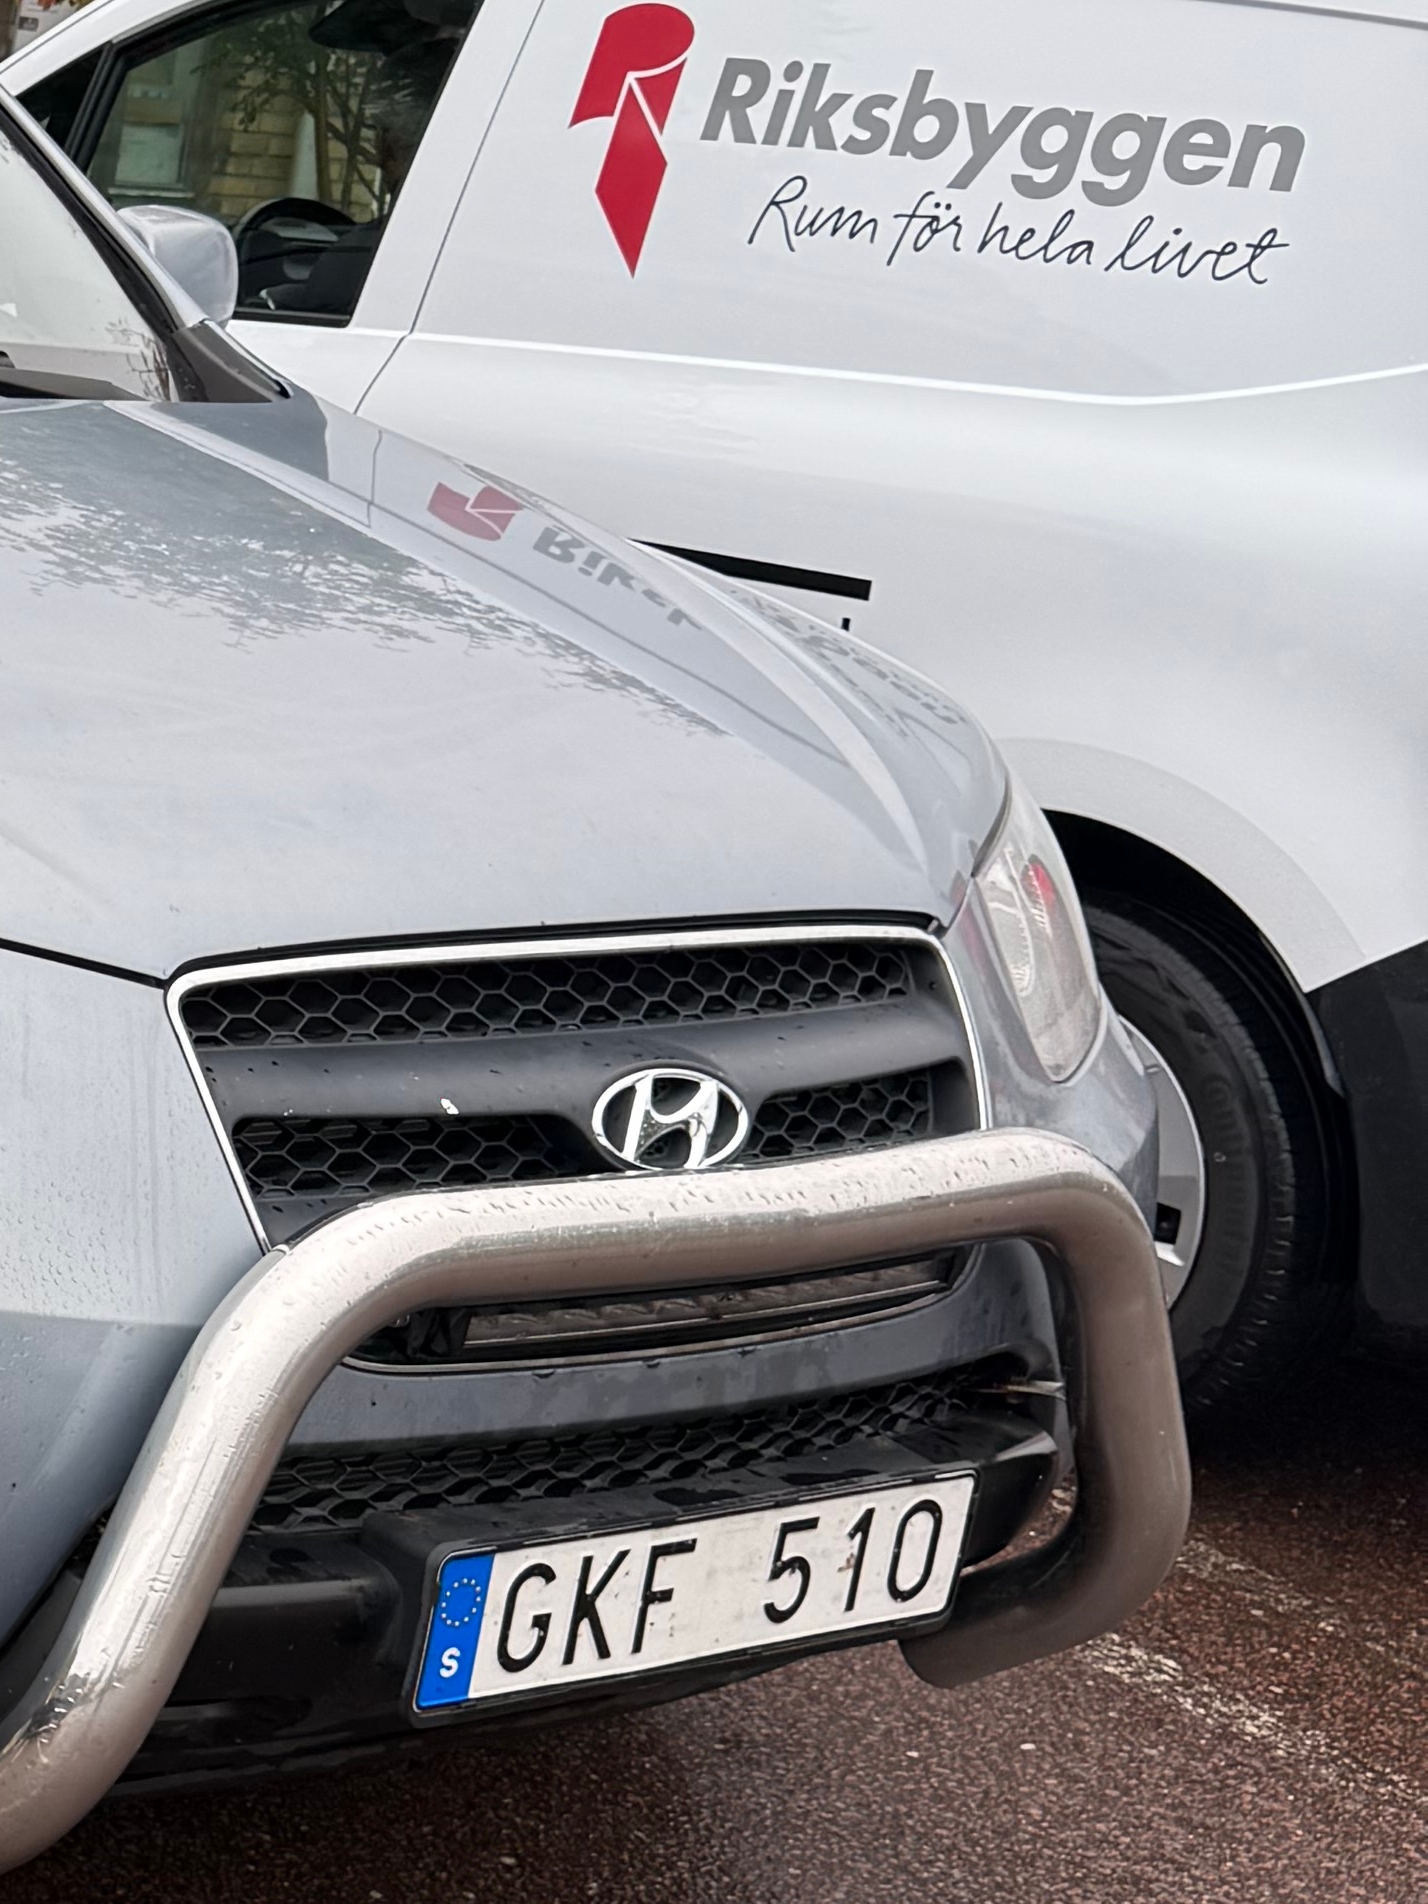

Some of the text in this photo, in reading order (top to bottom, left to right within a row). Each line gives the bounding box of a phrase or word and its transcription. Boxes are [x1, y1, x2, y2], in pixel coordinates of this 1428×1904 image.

[699, 56, 1306, 208] Riksbyggen
[746, 175, 1291, 285] Rum för hela livet
[496, 1498, 944, 1674] GKF 510
[439, 1646, 462, 1679] S
